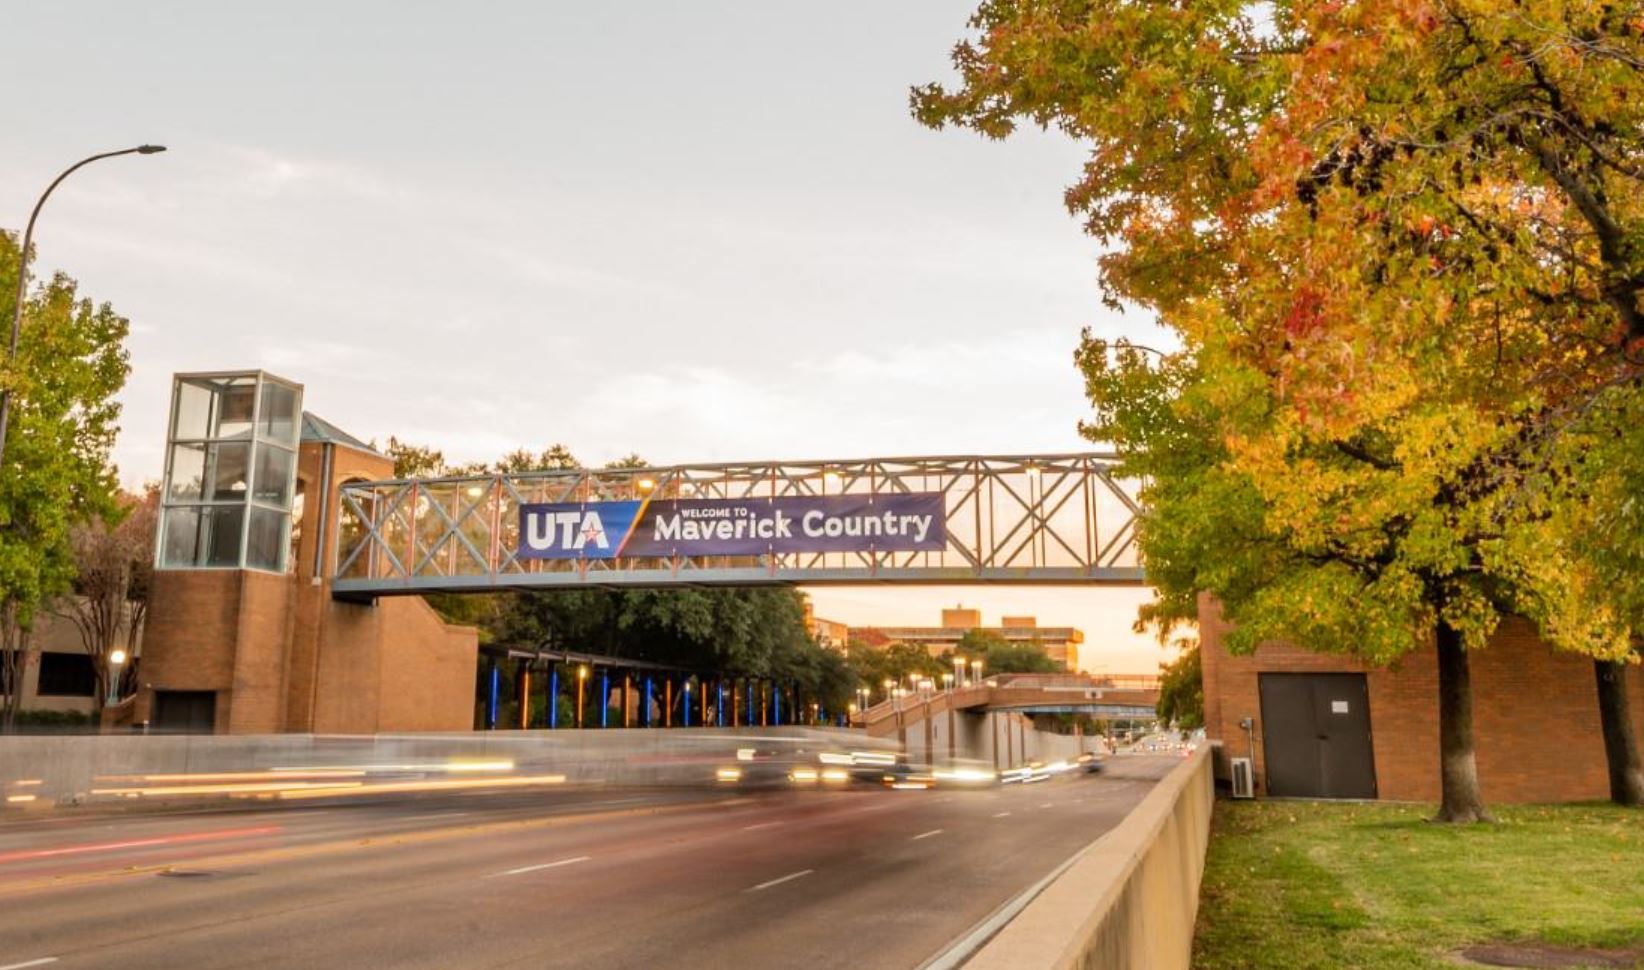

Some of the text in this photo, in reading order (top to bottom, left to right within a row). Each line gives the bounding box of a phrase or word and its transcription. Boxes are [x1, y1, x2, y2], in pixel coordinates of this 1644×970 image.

[654, 510, 932, 542] Maverick Country
[681, 508, 748, 518] WELCOME TO
[527, 511, 609, 550] UTA
